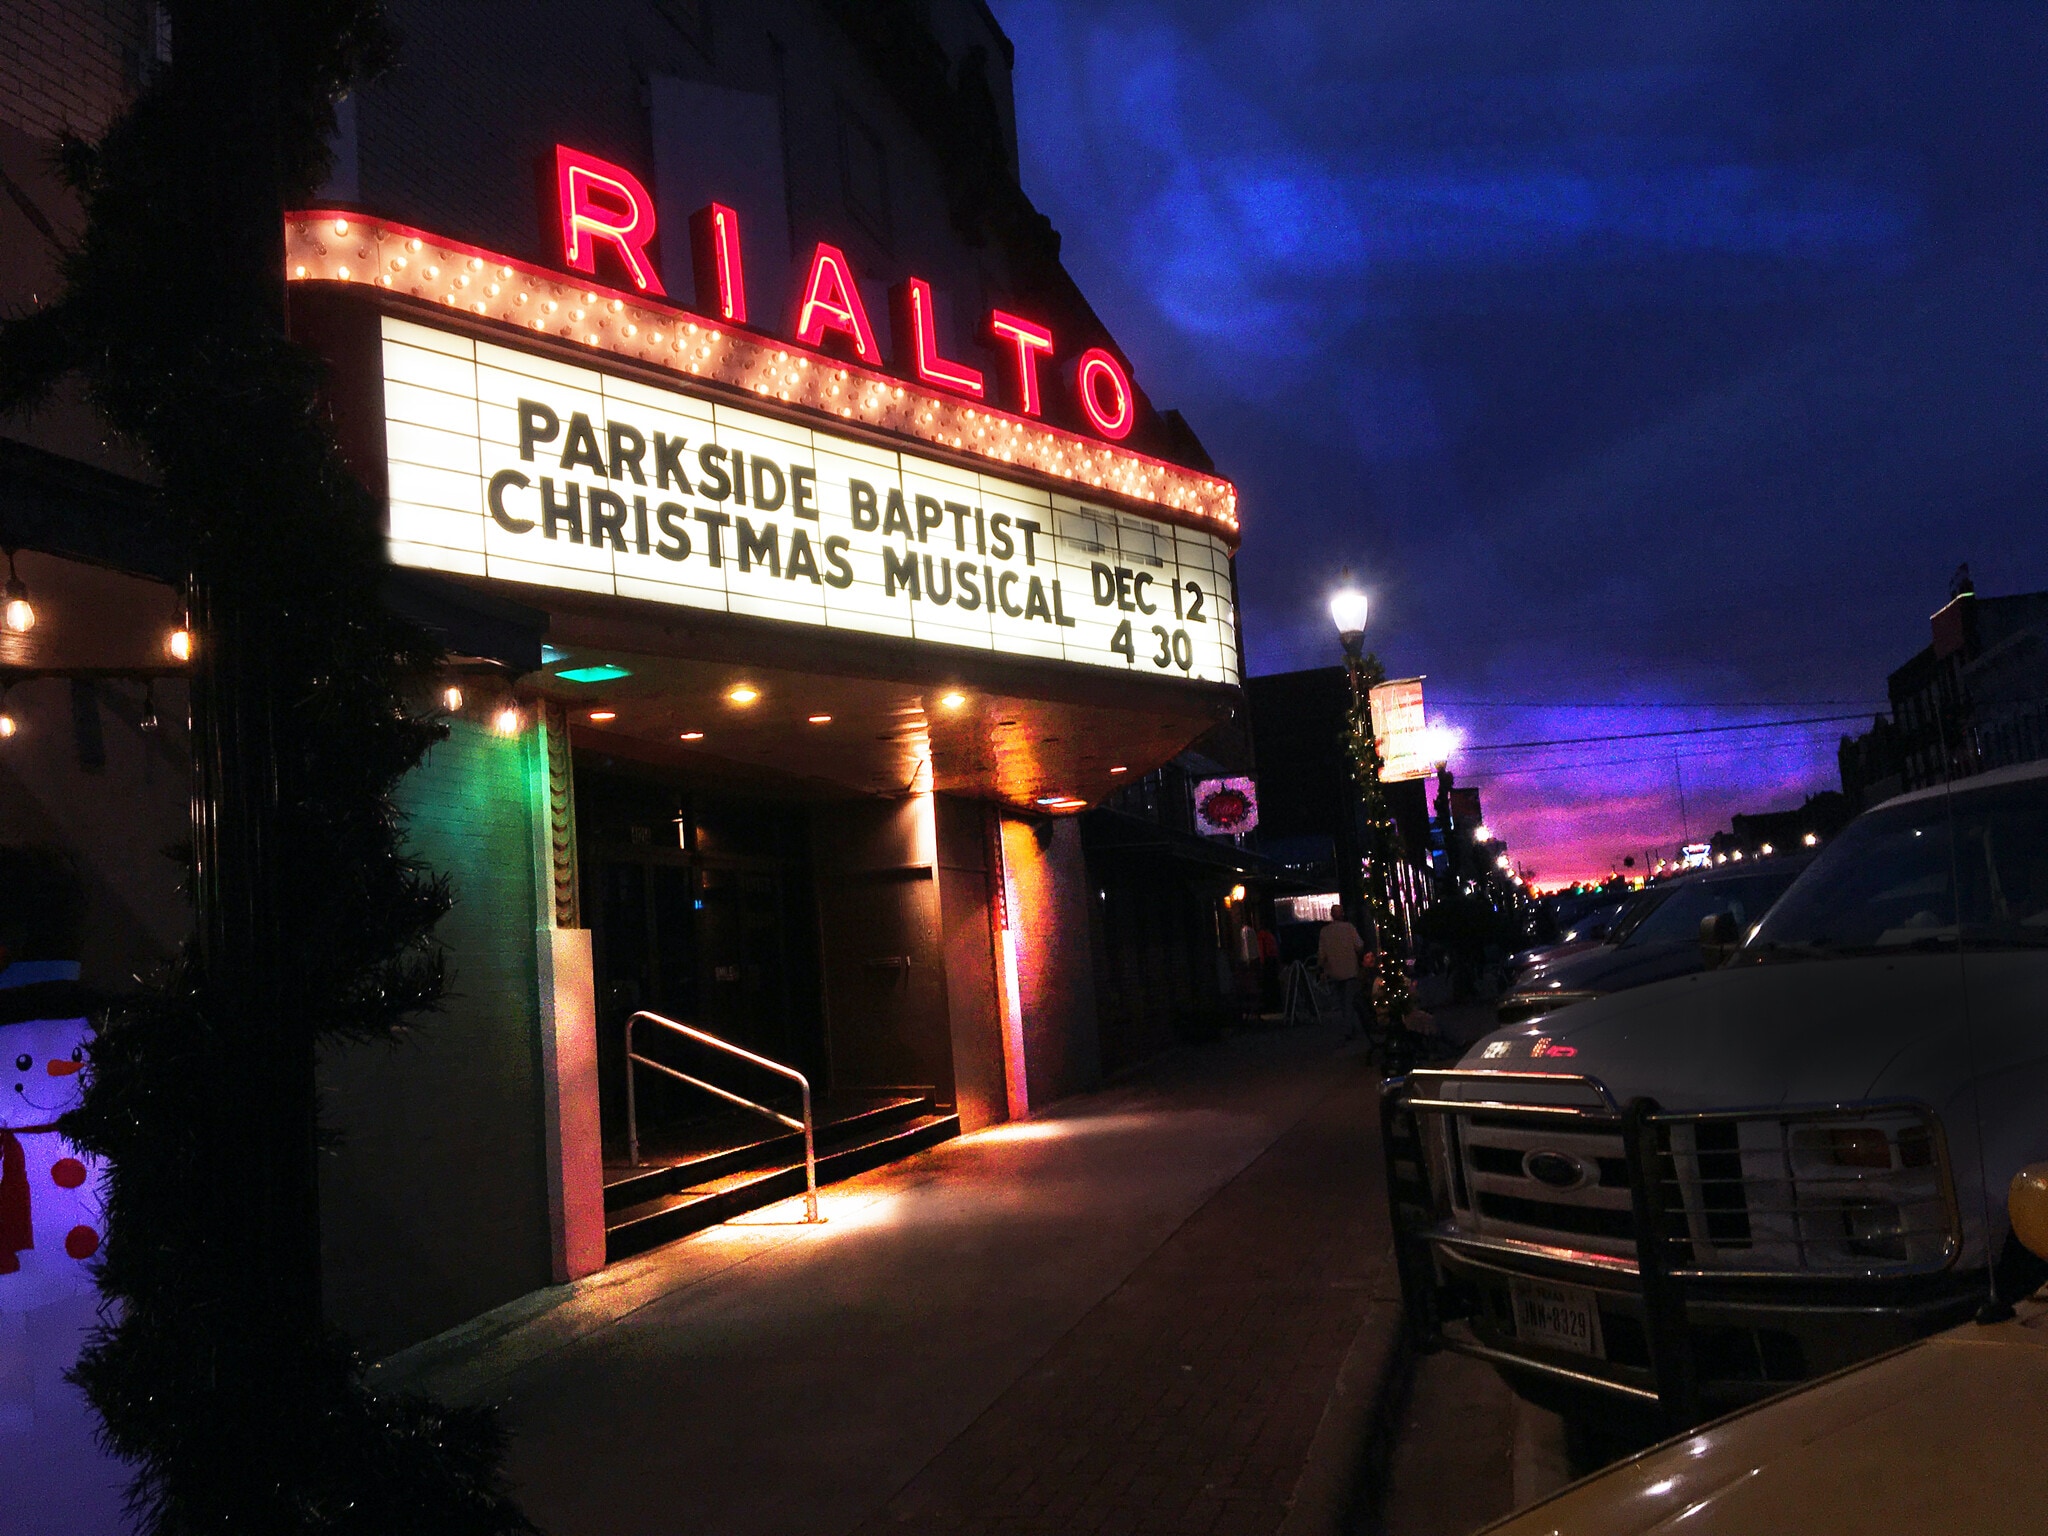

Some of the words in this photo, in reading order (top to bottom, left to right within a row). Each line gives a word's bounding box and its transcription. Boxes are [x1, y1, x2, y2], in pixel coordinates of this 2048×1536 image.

[556, 143, 1135, 440] RIALTO
[488, 469, 853, 589] CHRISTMAS
[882, 545, 1076, 628] MUSICAL
[517, 397, 819, 522] PARKSIDE
[848, 477, 1041, 566] BAPTIST
[1091, 560, 1157, 615] DEC
[1172, 578, 1207, 623] 12
[1110, 619, 1135, 663] 4
[1151, 625, 1193, 671] 30
